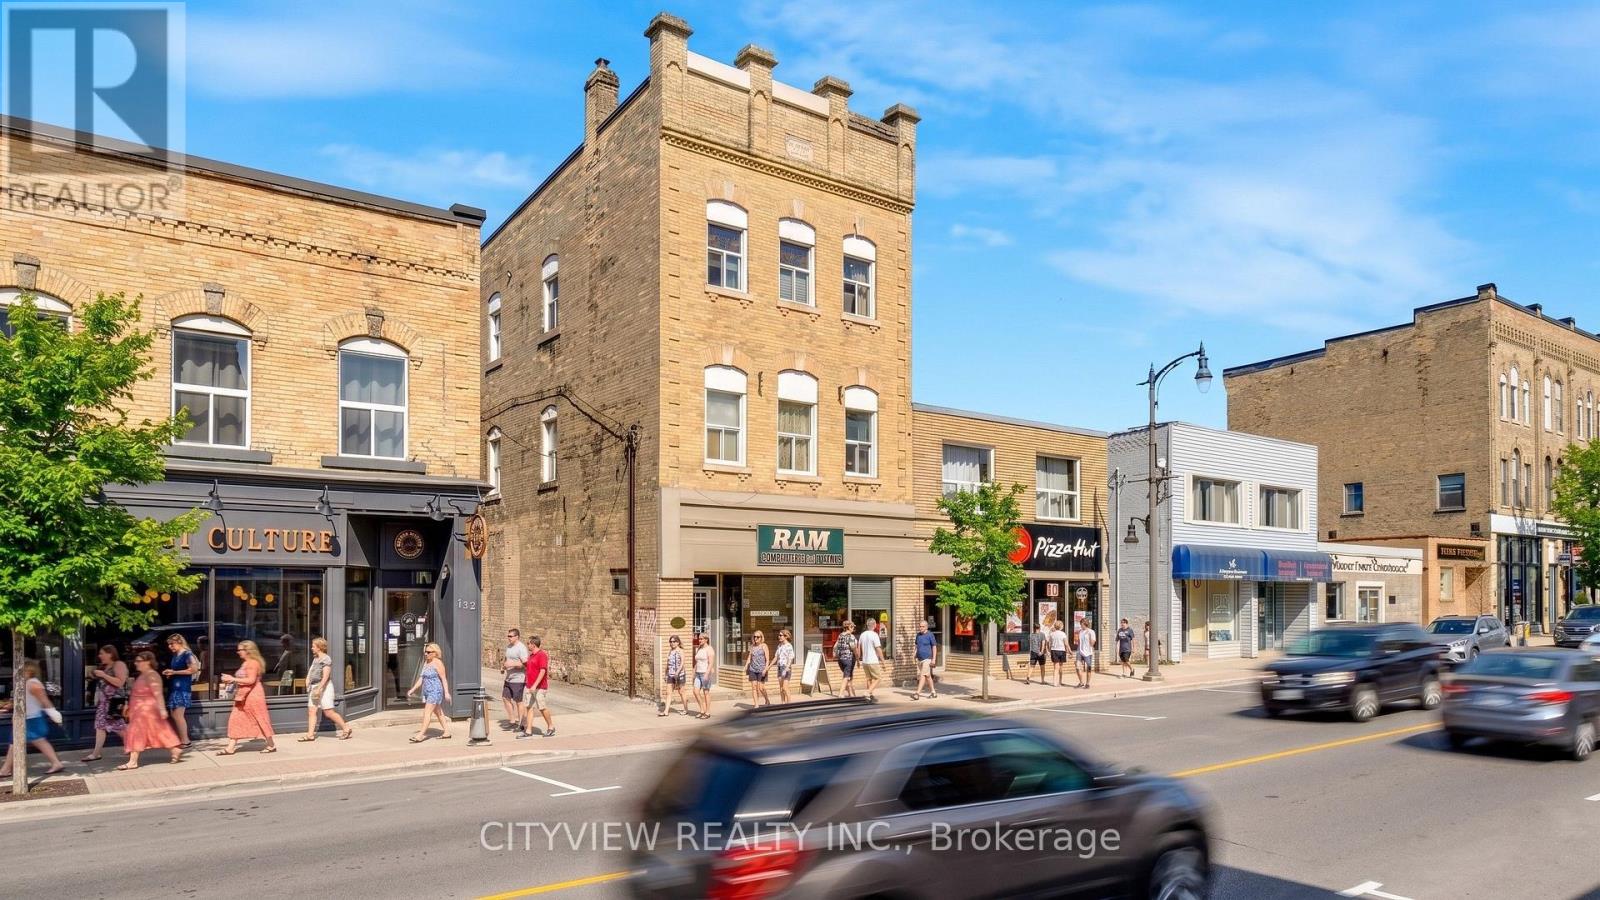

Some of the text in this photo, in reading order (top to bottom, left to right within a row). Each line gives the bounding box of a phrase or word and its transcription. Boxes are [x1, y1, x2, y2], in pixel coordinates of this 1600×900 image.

[208, 527, 334, 553] CULTURE
[771, 528, 831, 551] RAM
[1033, 536, 1100, 558] Pizza Hut
[457, 599, 476, 610] 132
